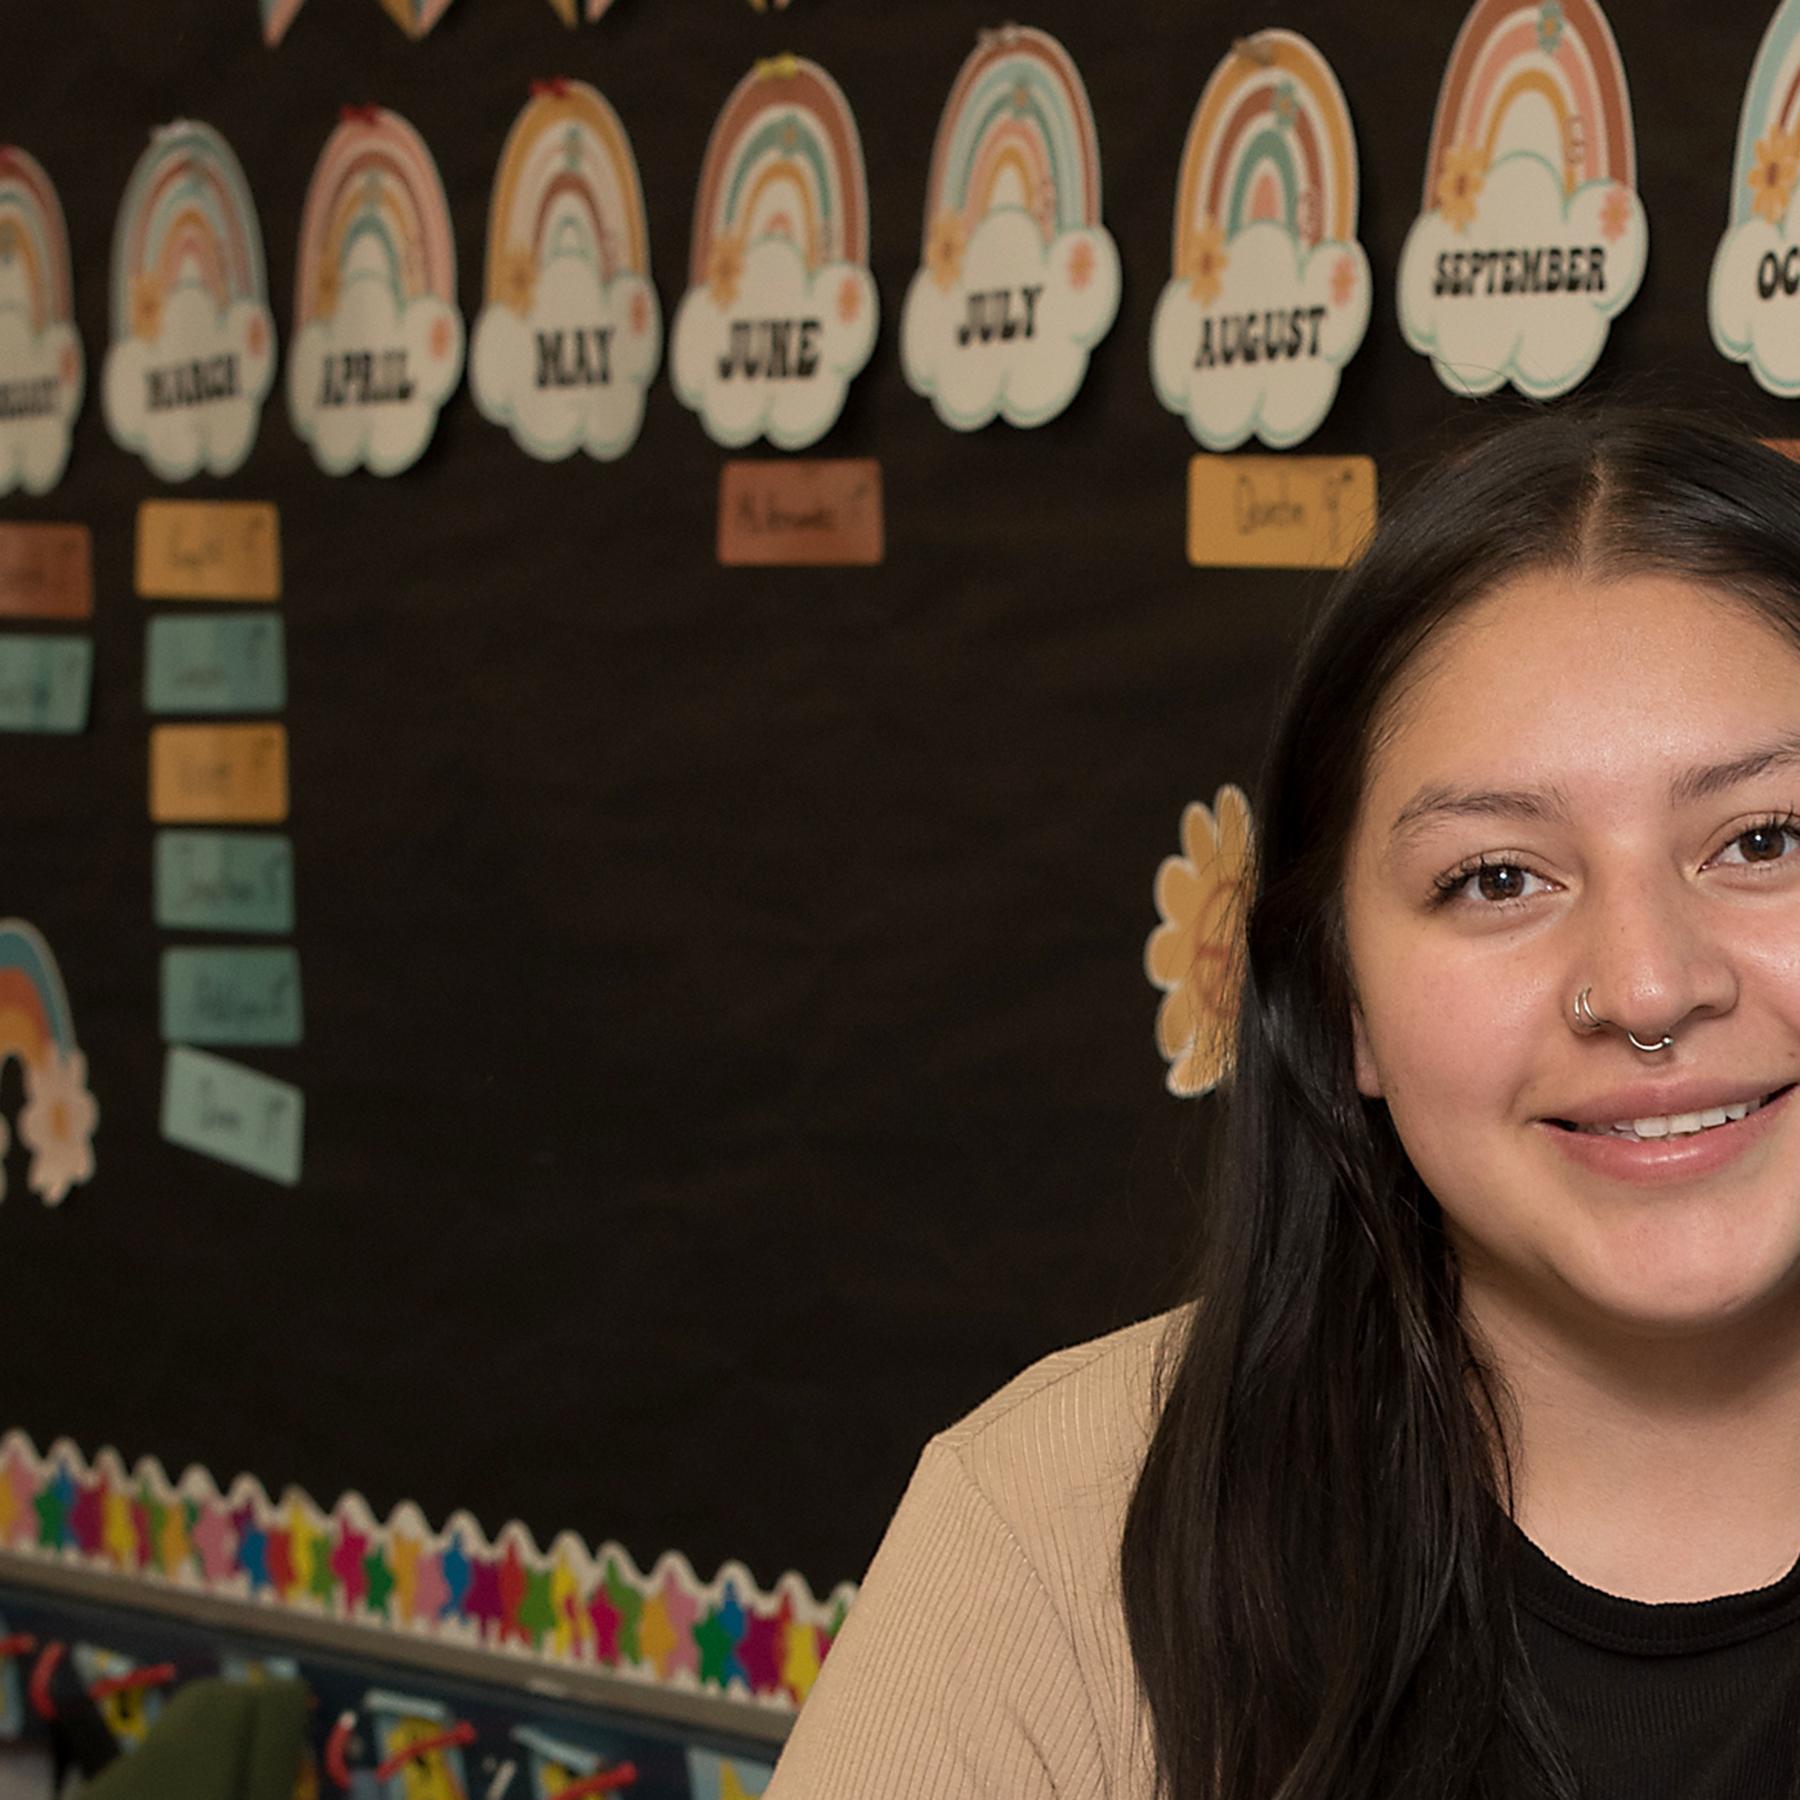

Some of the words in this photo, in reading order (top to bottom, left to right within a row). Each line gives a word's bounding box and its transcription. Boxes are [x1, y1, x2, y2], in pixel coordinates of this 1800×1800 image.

[1433, 246, 1606, 297] SEPTEMBER
[956, 285, 1042, 346] JULY
[1196, 305, 1327, 368] AUGUST
[316, 350, 416, 405] APRIL
[535, 328, 615, 388] MAY
[718, 319, 821, 381] JUNE
